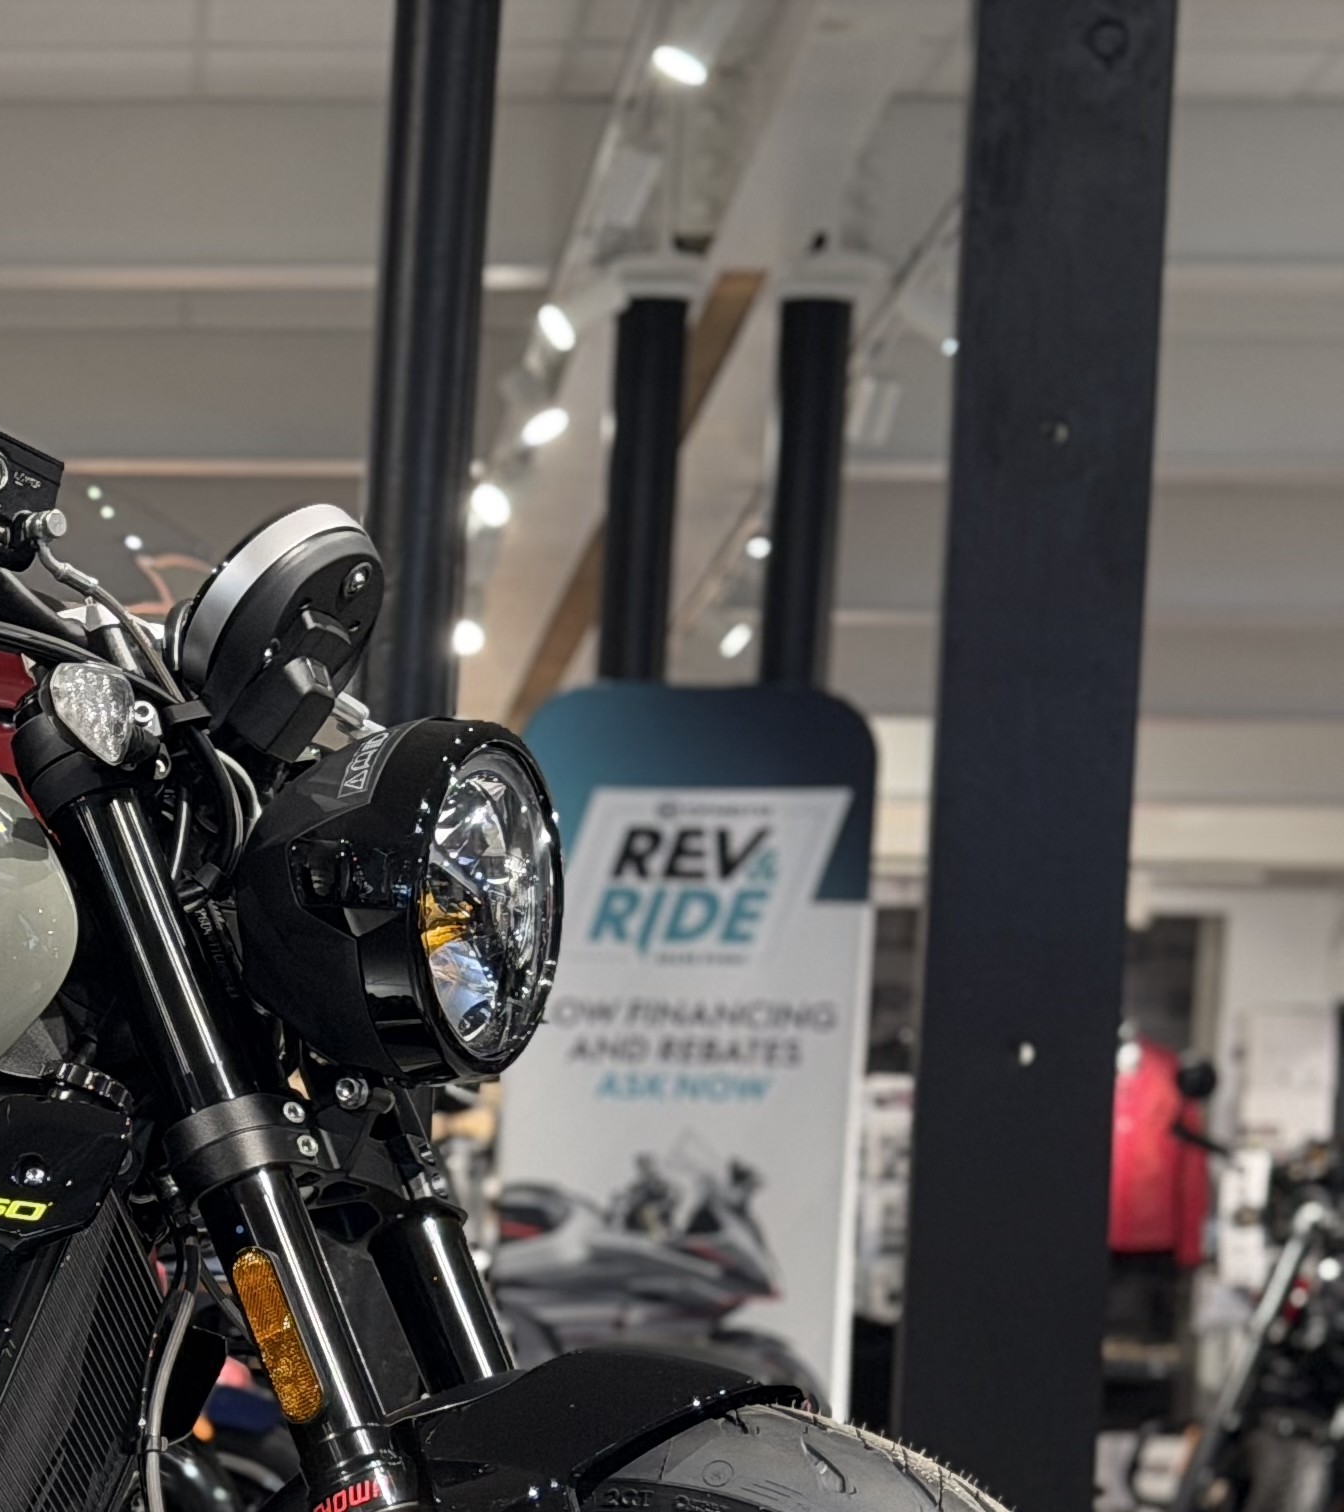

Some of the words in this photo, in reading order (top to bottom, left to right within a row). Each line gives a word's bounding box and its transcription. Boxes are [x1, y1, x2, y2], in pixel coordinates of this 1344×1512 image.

[613, 825, 770, 880] REV
[589, 887, 769, 953] RIDE
[540, 996, 618, 1030] OW
[624, 999, 837, 1032] FINANCING
[567, 1036, 647, 1063] AND
[654, 1037, 803, 1067] REBATES
[597, 1072, 662, 1098] ASK
[673, 1075, 773, 1100] NOW
